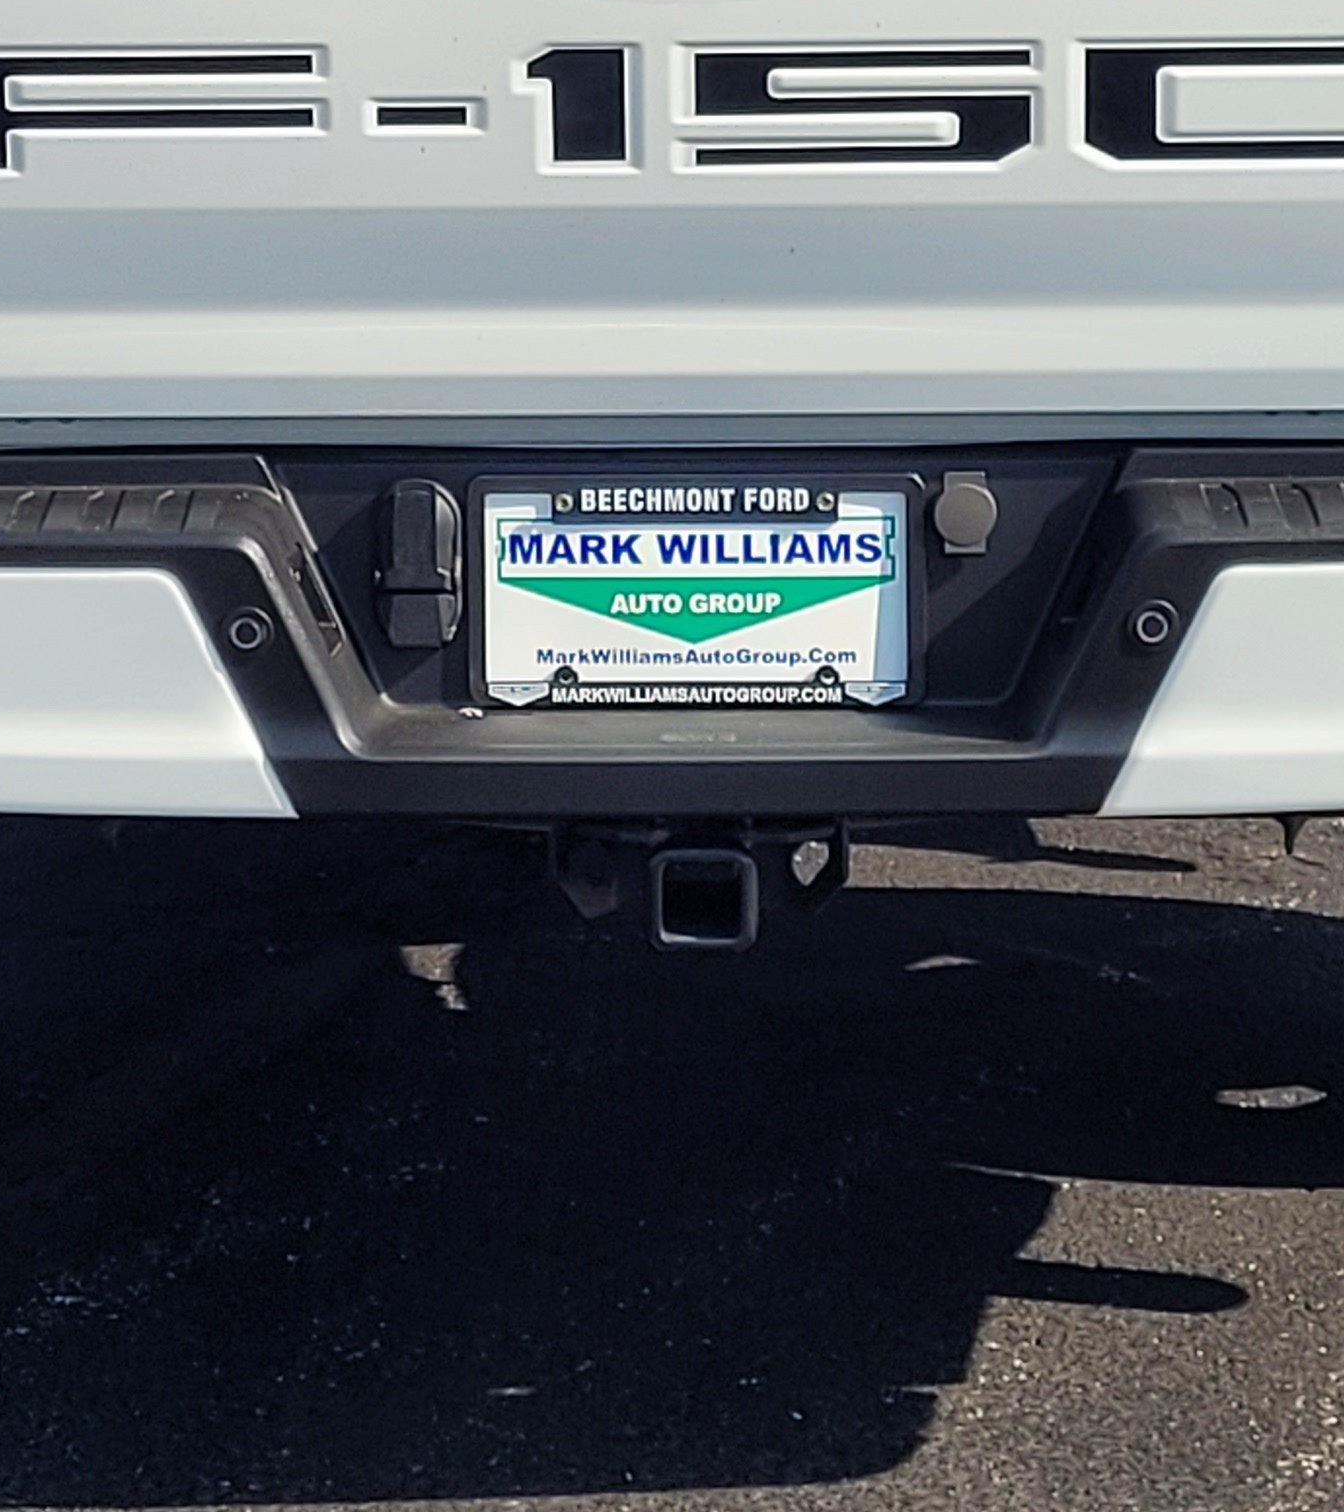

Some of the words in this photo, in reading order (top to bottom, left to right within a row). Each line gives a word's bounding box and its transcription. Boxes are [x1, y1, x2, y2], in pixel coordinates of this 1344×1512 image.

[580, 488, 735, 512] BEECHMONT
[743, 487, 810, 512] FORD
[509, 533, 642, 564] MARK
[656, 533, 882, 564] WILLIAMS
[610, 593, 682, 614] AUTO
[688, 592, 781, 614] GROUP
[536, 647, 857, 667] MarkWilliamsAutoGroup.Com
[551, 687, 843, 704] MARKWILLIAMSAUTOGROUP.COM
